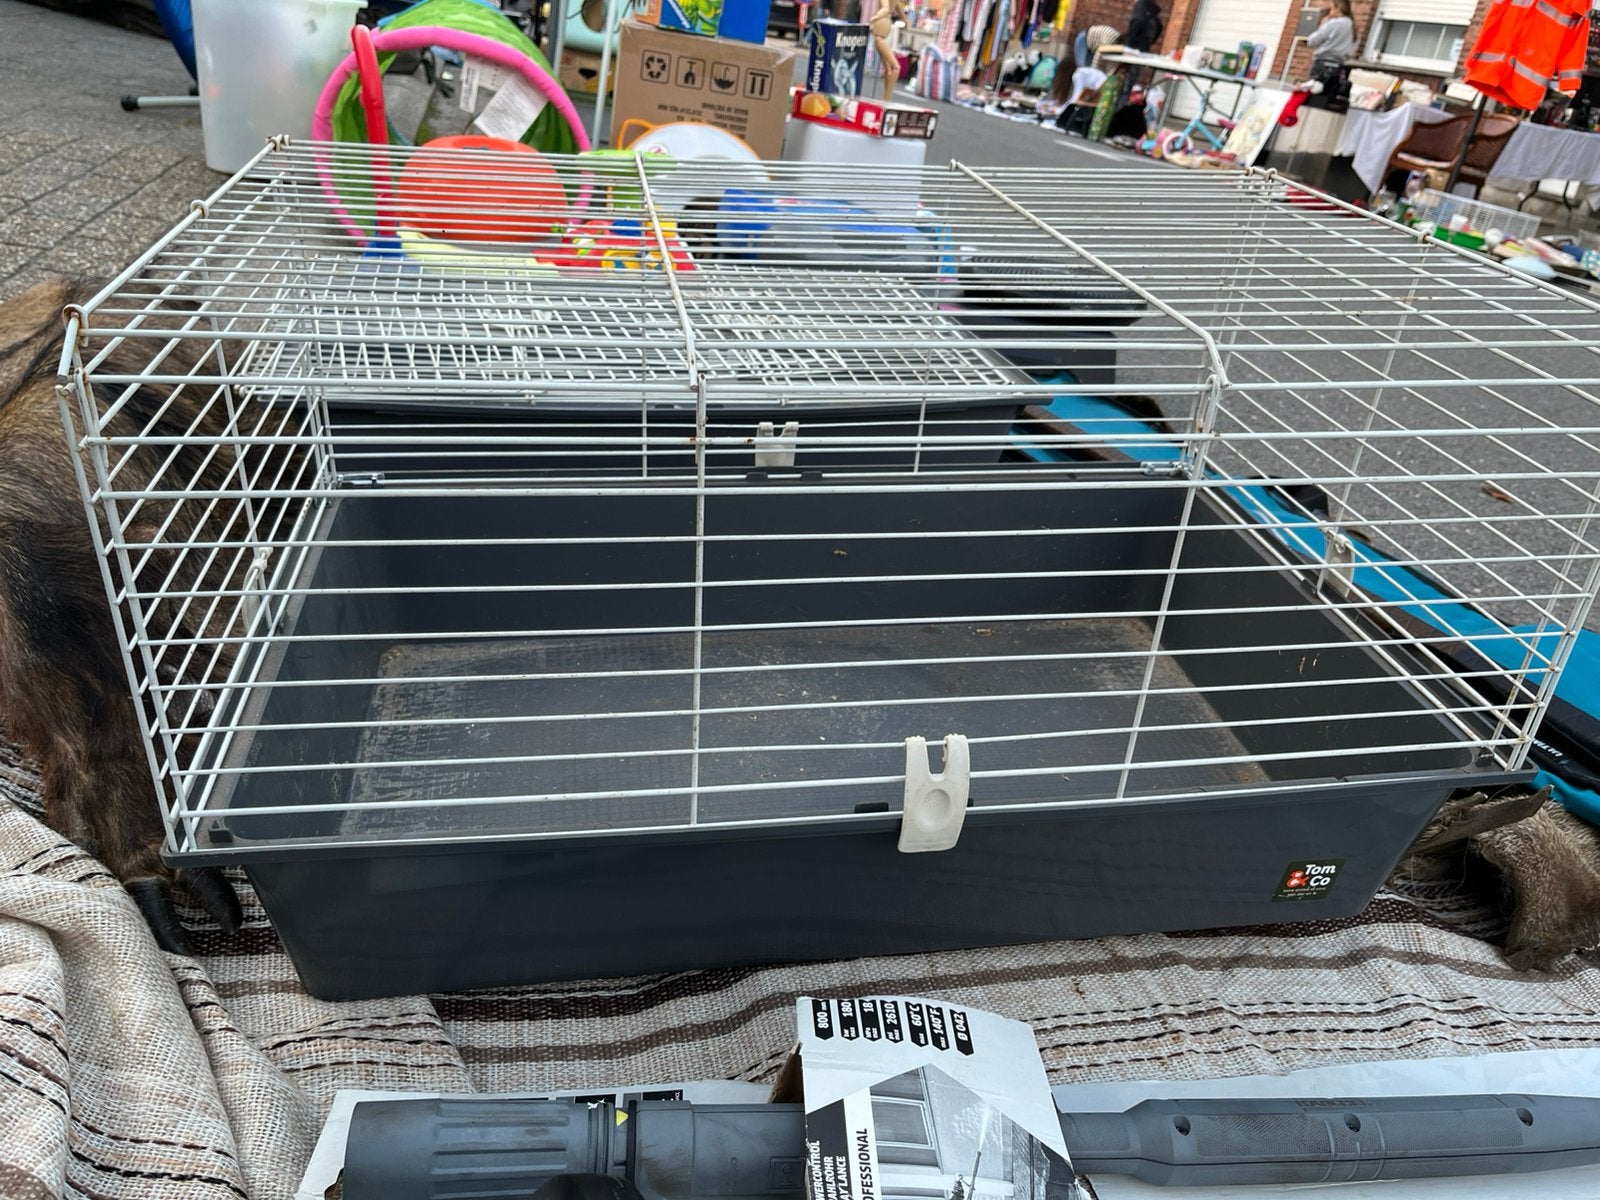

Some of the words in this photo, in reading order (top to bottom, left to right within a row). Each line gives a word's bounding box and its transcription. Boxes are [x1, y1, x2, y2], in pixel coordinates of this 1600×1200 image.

[835, 32, 867, 51] Knopen
[1305, 864, 1336, 876] Tom
[1309, 875, 1331, 887] Co
[841, 1001, 853, 1017] 180
[862, 1002, 874, 1013] 18
[884, 1003, 898, 1025] 2610
[910, 1005, 922, 1027] 60°C
[817, 1012, 829, 1029] 800
[929, 1008, 944, 1035] 140°F
[953, 1013, 965, 1032] 042
[823, 1156, 838, 1200] AHLROHR
[835, 1155, 848, 1187] LANCE
